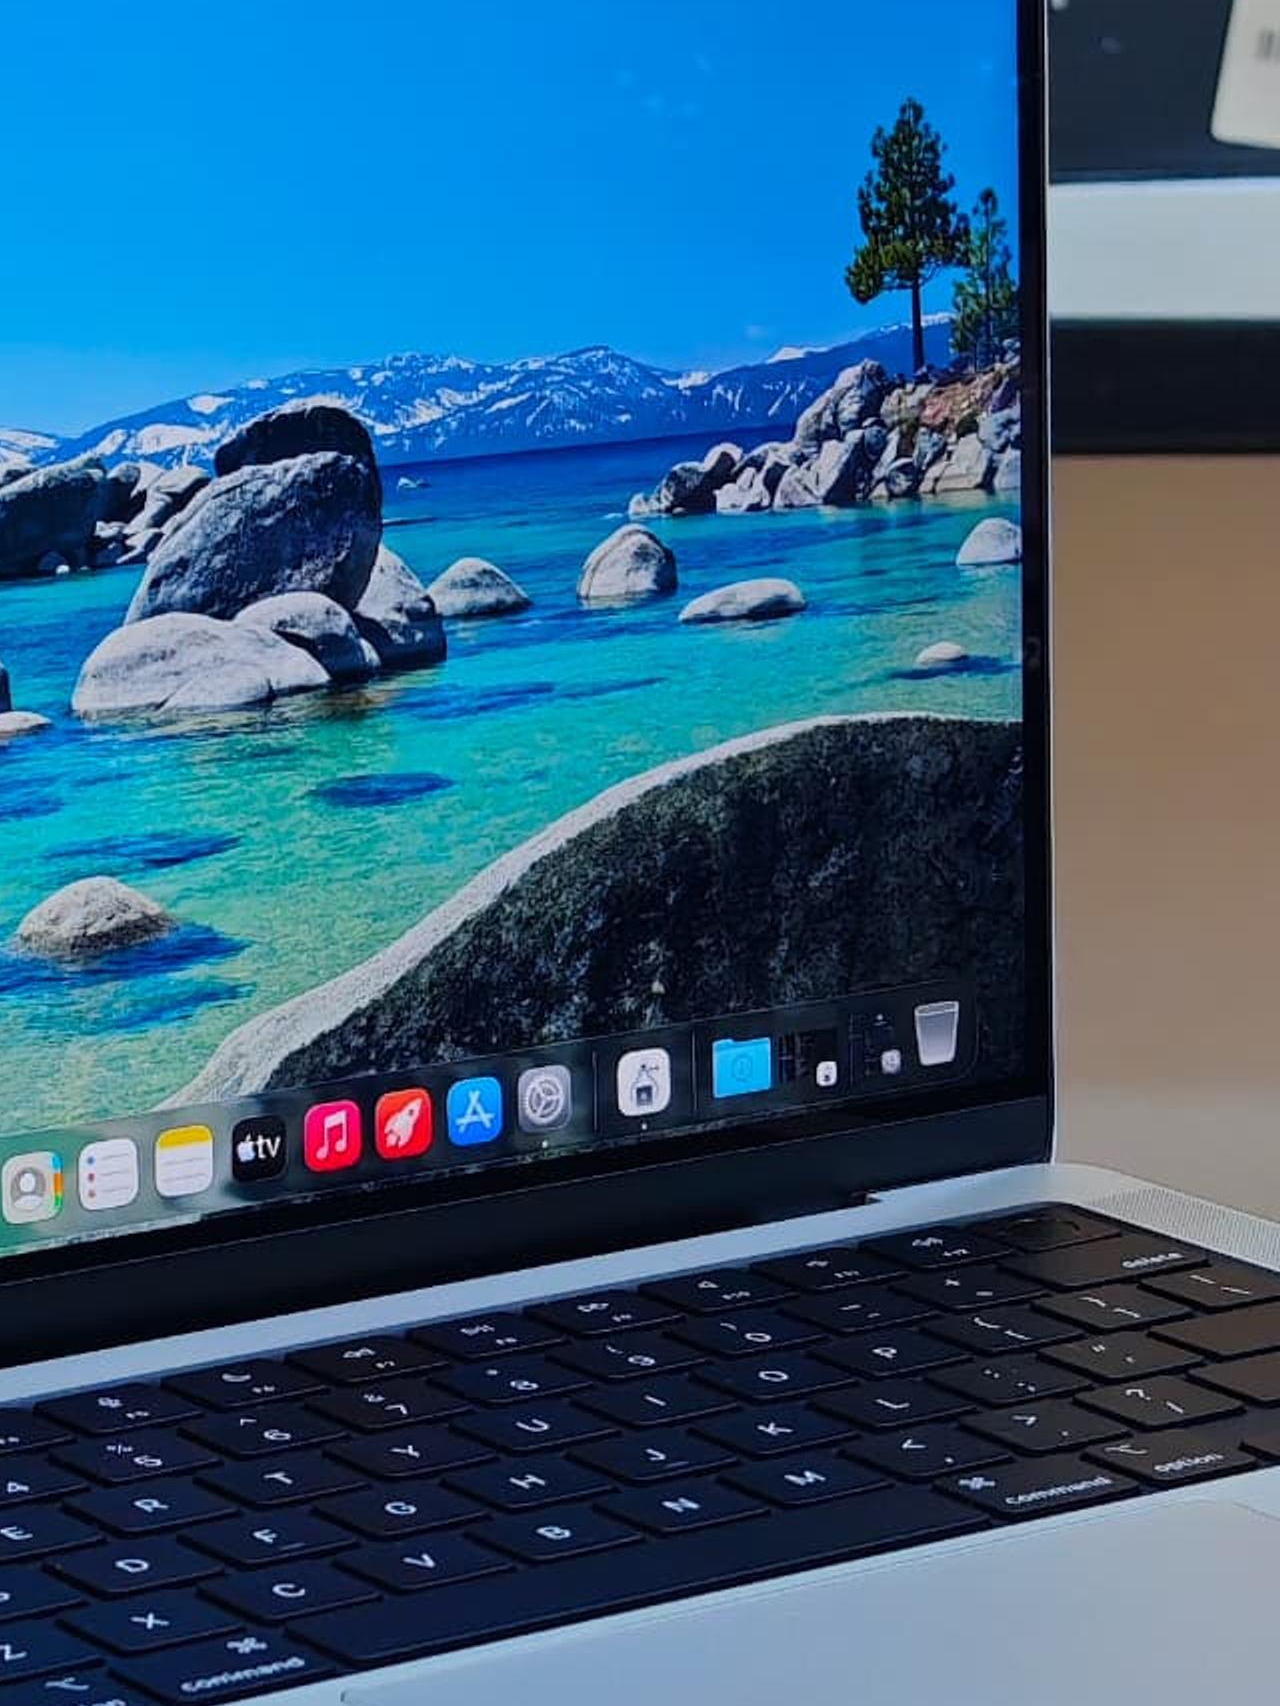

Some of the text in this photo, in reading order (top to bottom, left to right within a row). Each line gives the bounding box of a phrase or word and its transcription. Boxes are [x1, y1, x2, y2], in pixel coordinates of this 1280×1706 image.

[256, 1134, 282, 1159] tv
[744, 1332, 772, 1343] 0
[872, 1347, 897, 1359] P
[627, 1355, 656, 1366] 9
[758, 1370, 789, 1382] O
[509, 1380, 539, 1391] 8
[385, 1404, 408, 1415] 7
[875, 1398, 910, 1410] L
[516, 1418, 550, 1433] U
[757, 1422, 793, 1436] K
[263, 1429, 292, 1441] 6
[391, 1444, 420, 1458] Y
[645, 1448, 666, 1461] J
[133, 1454, 163, 1467] 5
[1153, 1453, 1224, 1473] option
[263, 1471, 293, 1485] T
[509, 1474, 546, 1489] H
[784, 1470, 826, 1486] M
[6, 1481, 30, 1494] 4
[1005, 1475, 1112, 1505] command
[133, 1498, 169, 1513] R
[384, 1501, 417, 1515] G
[662, 1497, 700, 1513] N
[0, 1526, 33, 1541] E
[253, 1528, 277, 1544] F
[536, 1526, 571, 1540] B
[115, 1558, 149, 1573] D
[403, 1553, 436, 1568] V
[272, 1583, 306, 1598] C
[131, 1612, 169, 1630] X
[180, 1656, 305, 1693] command
